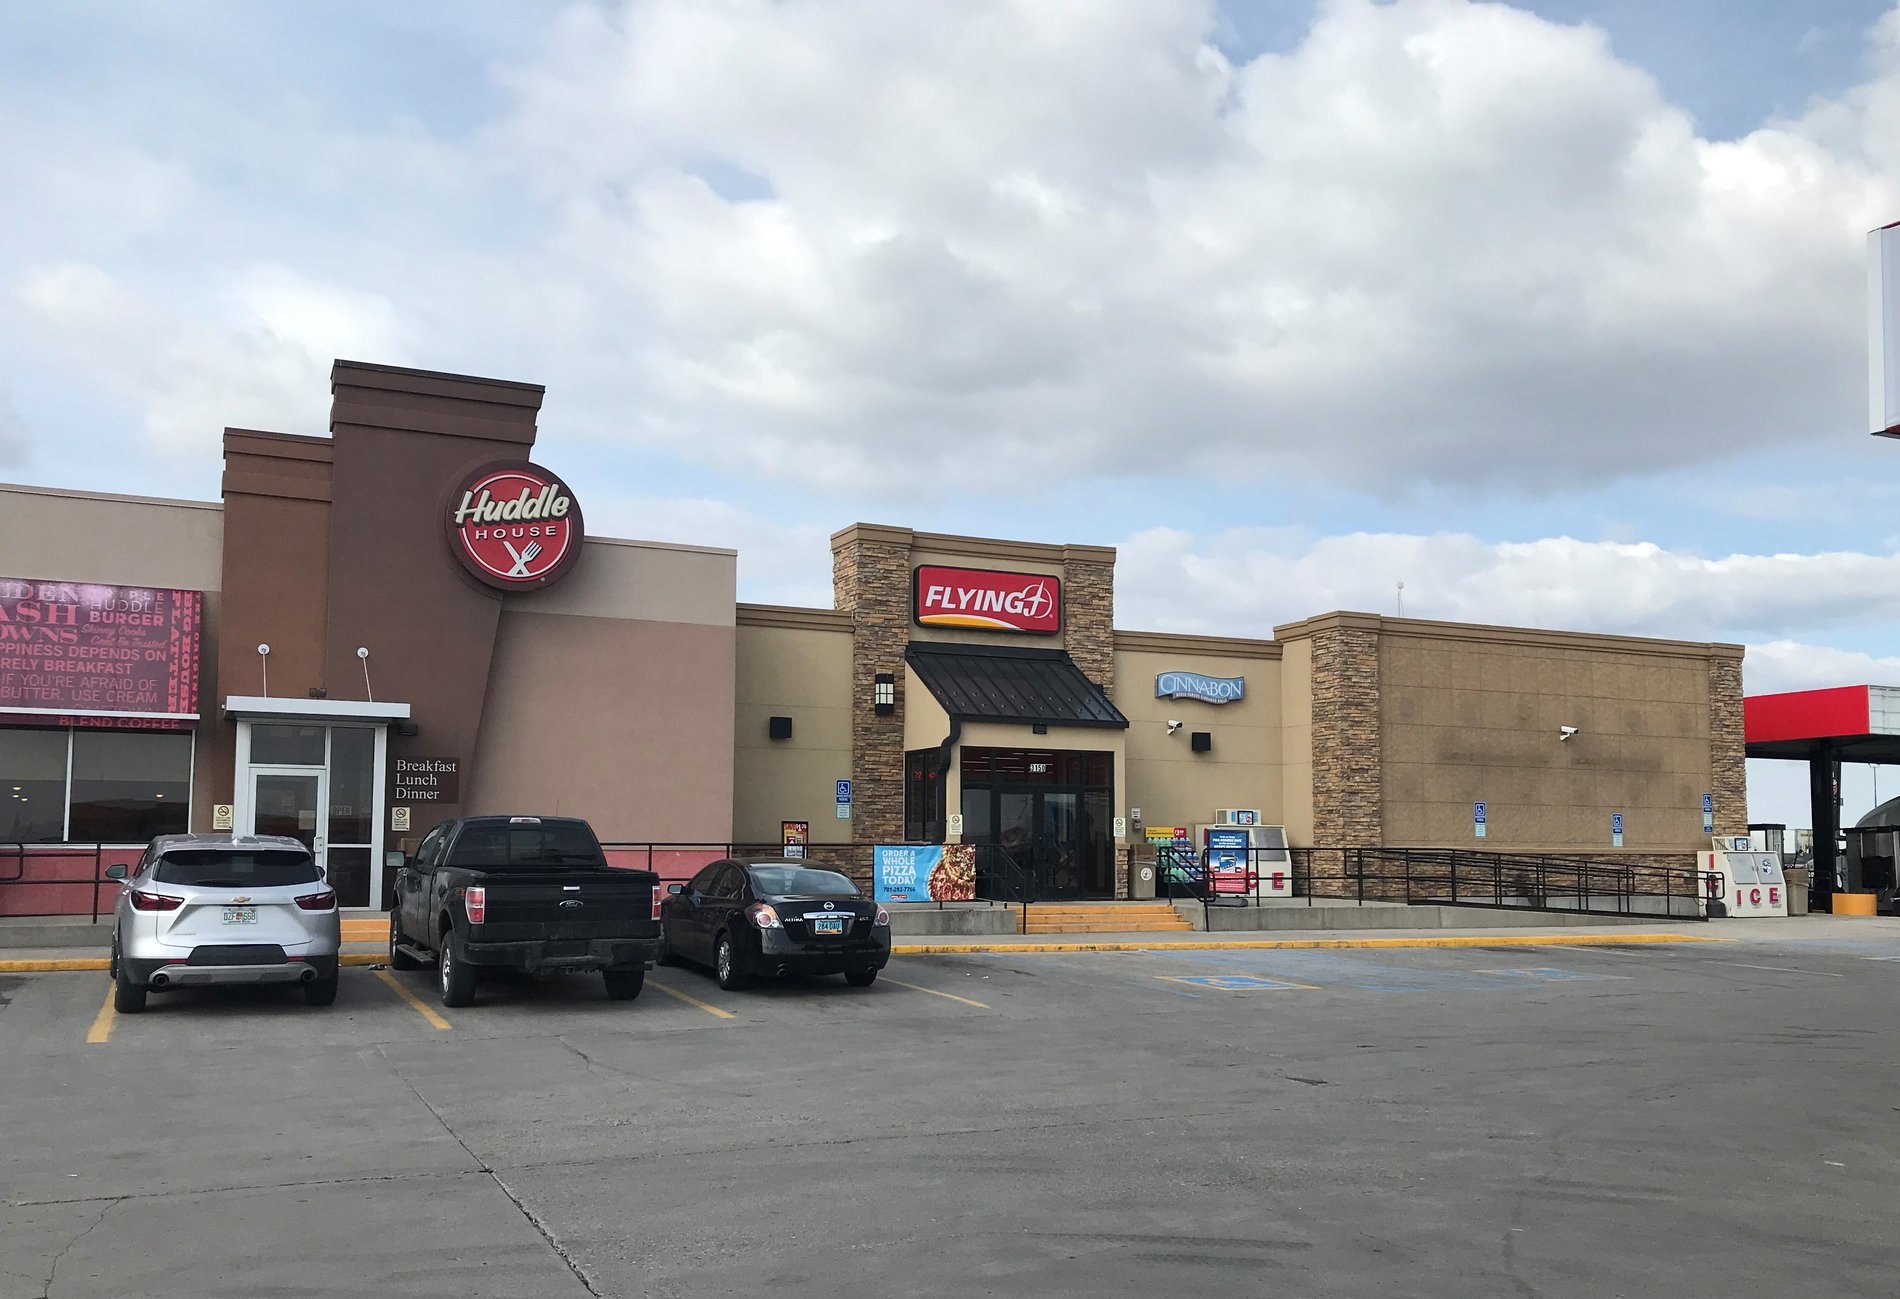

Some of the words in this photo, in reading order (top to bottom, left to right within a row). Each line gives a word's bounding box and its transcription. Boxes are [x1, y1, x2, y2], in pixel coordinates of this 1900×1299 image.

[454, 483, 570, 525] Huddle
[475, 525, 557, 540] HOUSE
[90, 598, 164, 614] HUDDLE
[925, 585, 1026, 614] FLYING
[89, 611, 164, 626] BURGER
[69, 646, 140, 661] DEPENDS
[145, 650, 167, 662] ON
[168, 591, 181, 713] PLATTER
[1, 658, 39, 671] RELY
[44, 660, 134, 675] BREAKFAST
[1, 673, 15, 684] IF
[20, 674, 75, 688] YOU'RE
[80, 677, 134, 690] AFRAID
[138, 679, 158, 691] OF
[1160, 674, 1244, 697] CINNABON
[72, 690, 101, 702] USE
[106, 691, 158, 703] CREAM
[396, 759, 457, 772] Breakfast
[396, 773, 437, 786] Lunch
[395, 787, 440, 800] Dinner
[882, 857, 916, 865] WHOLE
[882, 865, 916, 876] PIZZA
[882, 876, 916, 885] TODAY
[1736, 887, 1779, 907] ICE
